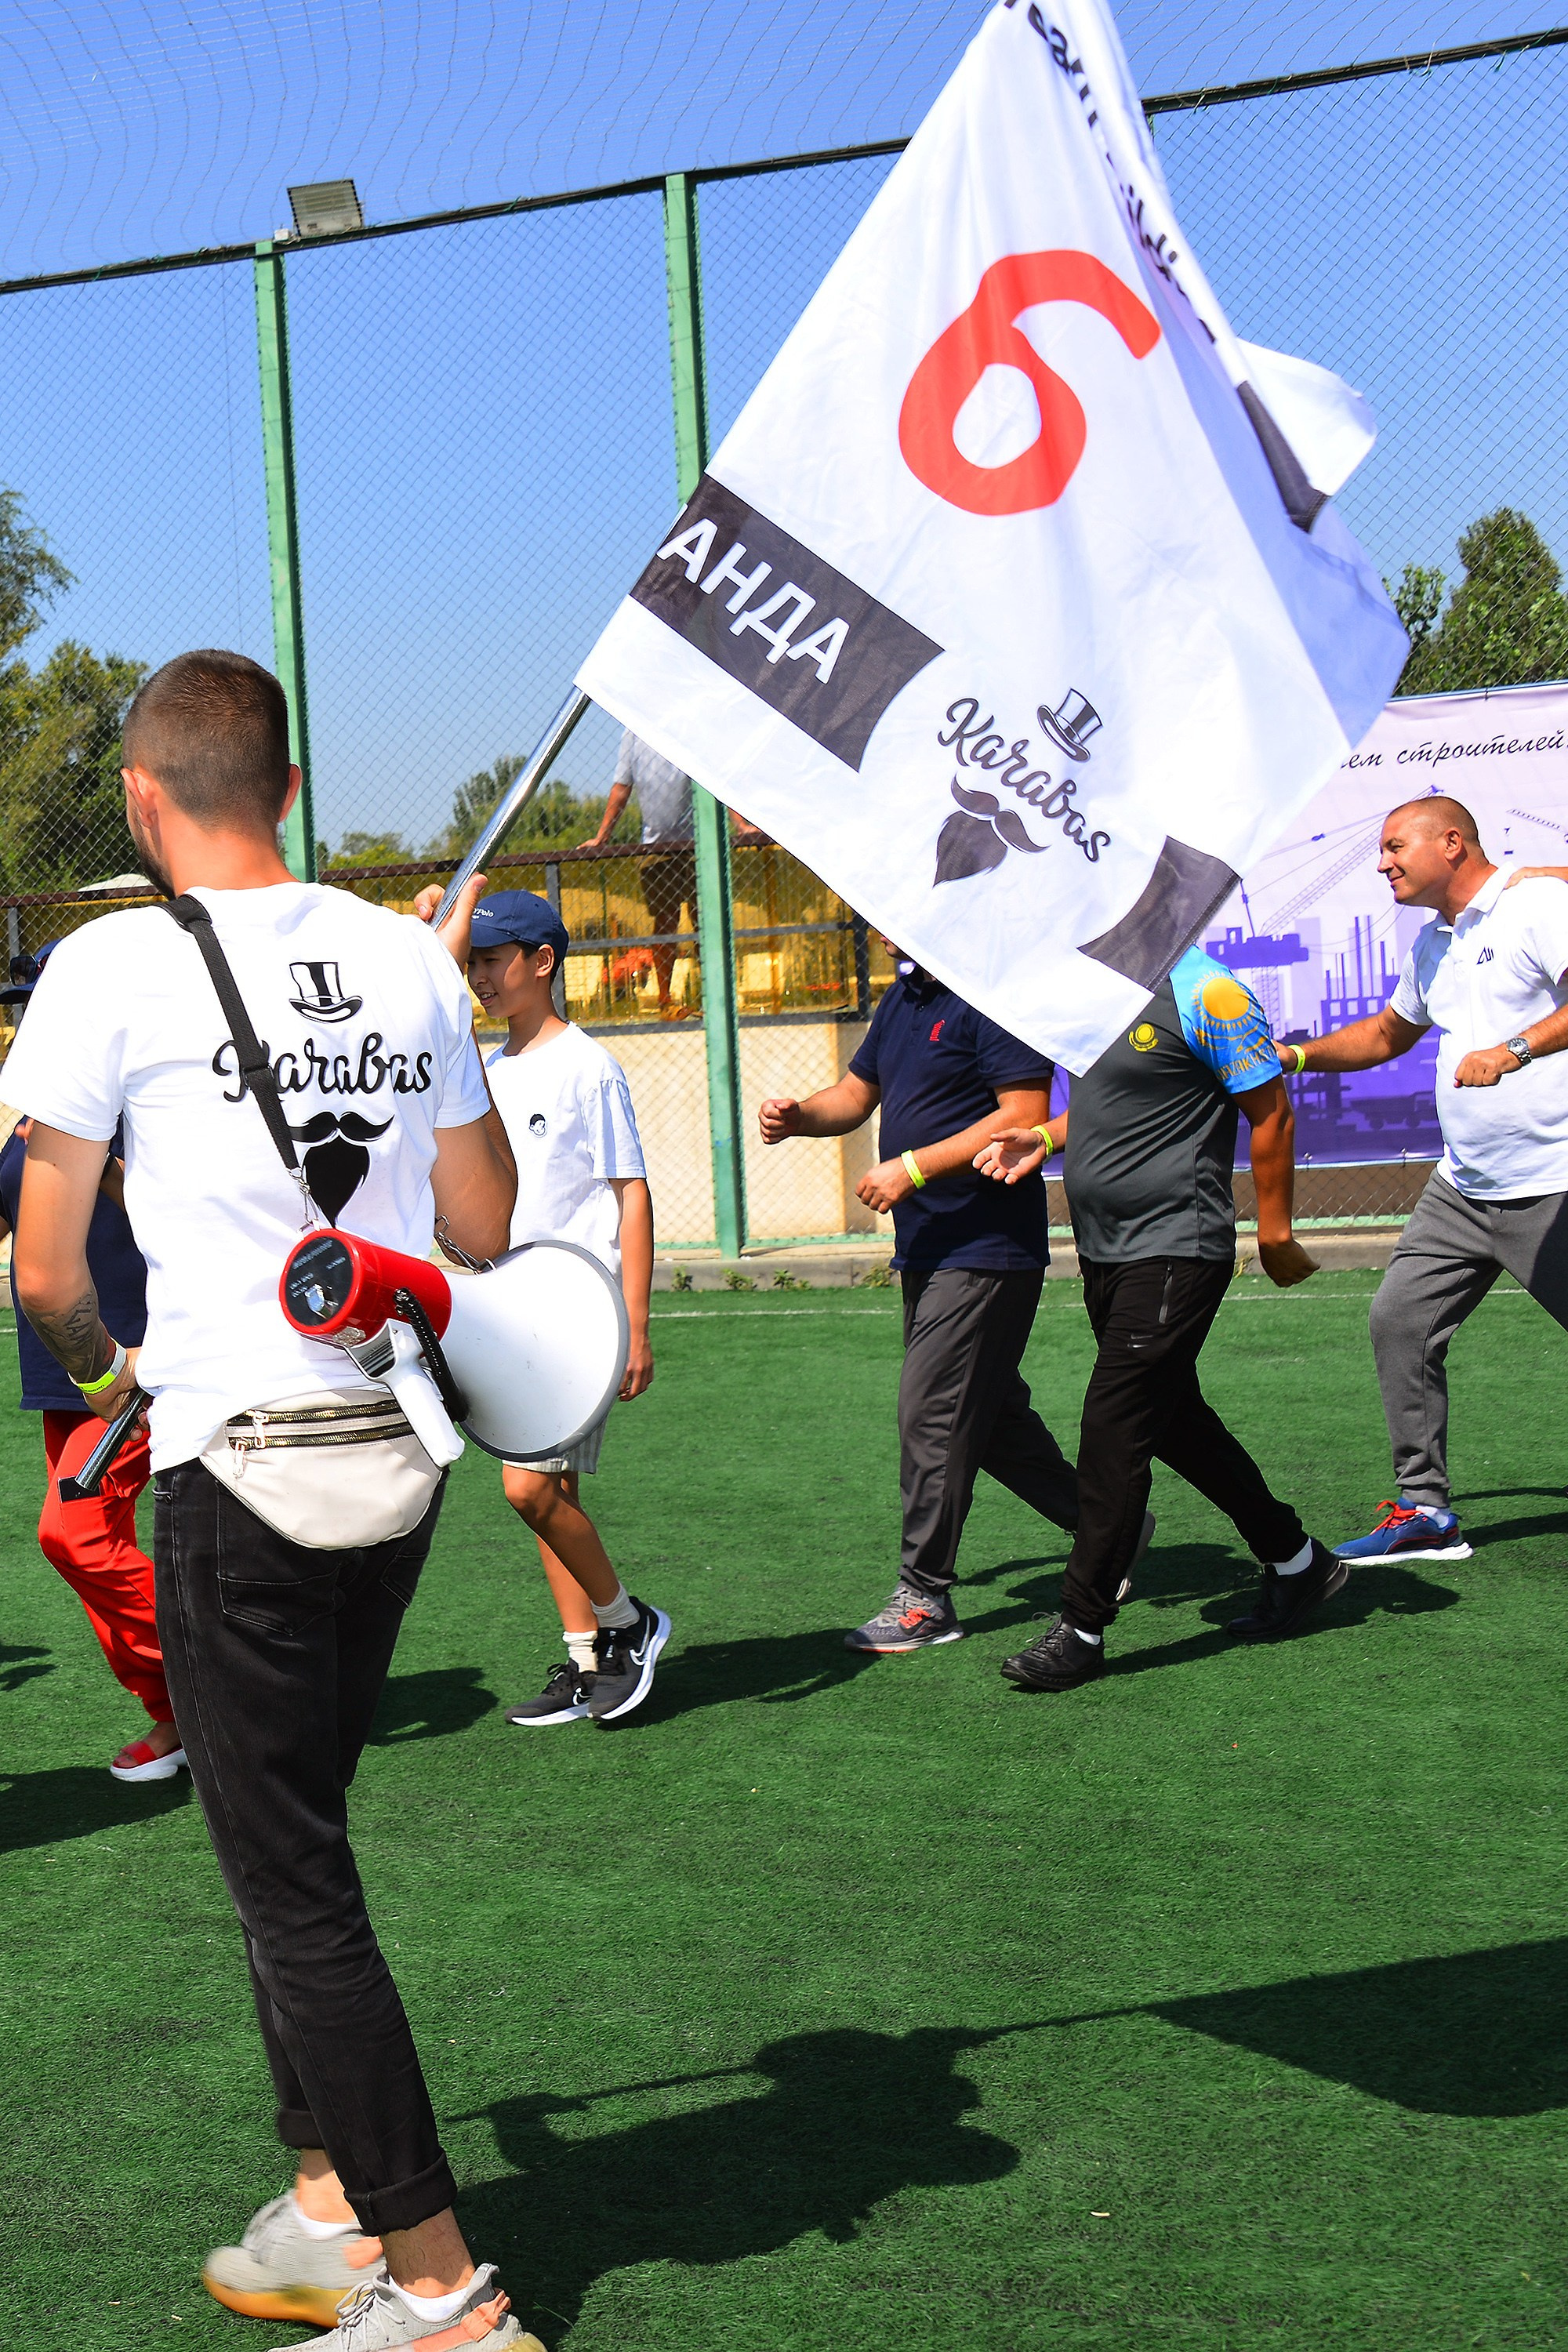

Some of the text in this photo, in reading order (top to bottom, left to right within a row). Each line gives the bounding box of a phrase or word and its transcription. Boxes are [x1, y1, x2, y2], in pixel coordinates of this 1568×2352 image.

[655, 517, 850, 684] АНДА
[938, 697, 1111, 862] Karabas
[1341, 753, 1384, 769] ем
